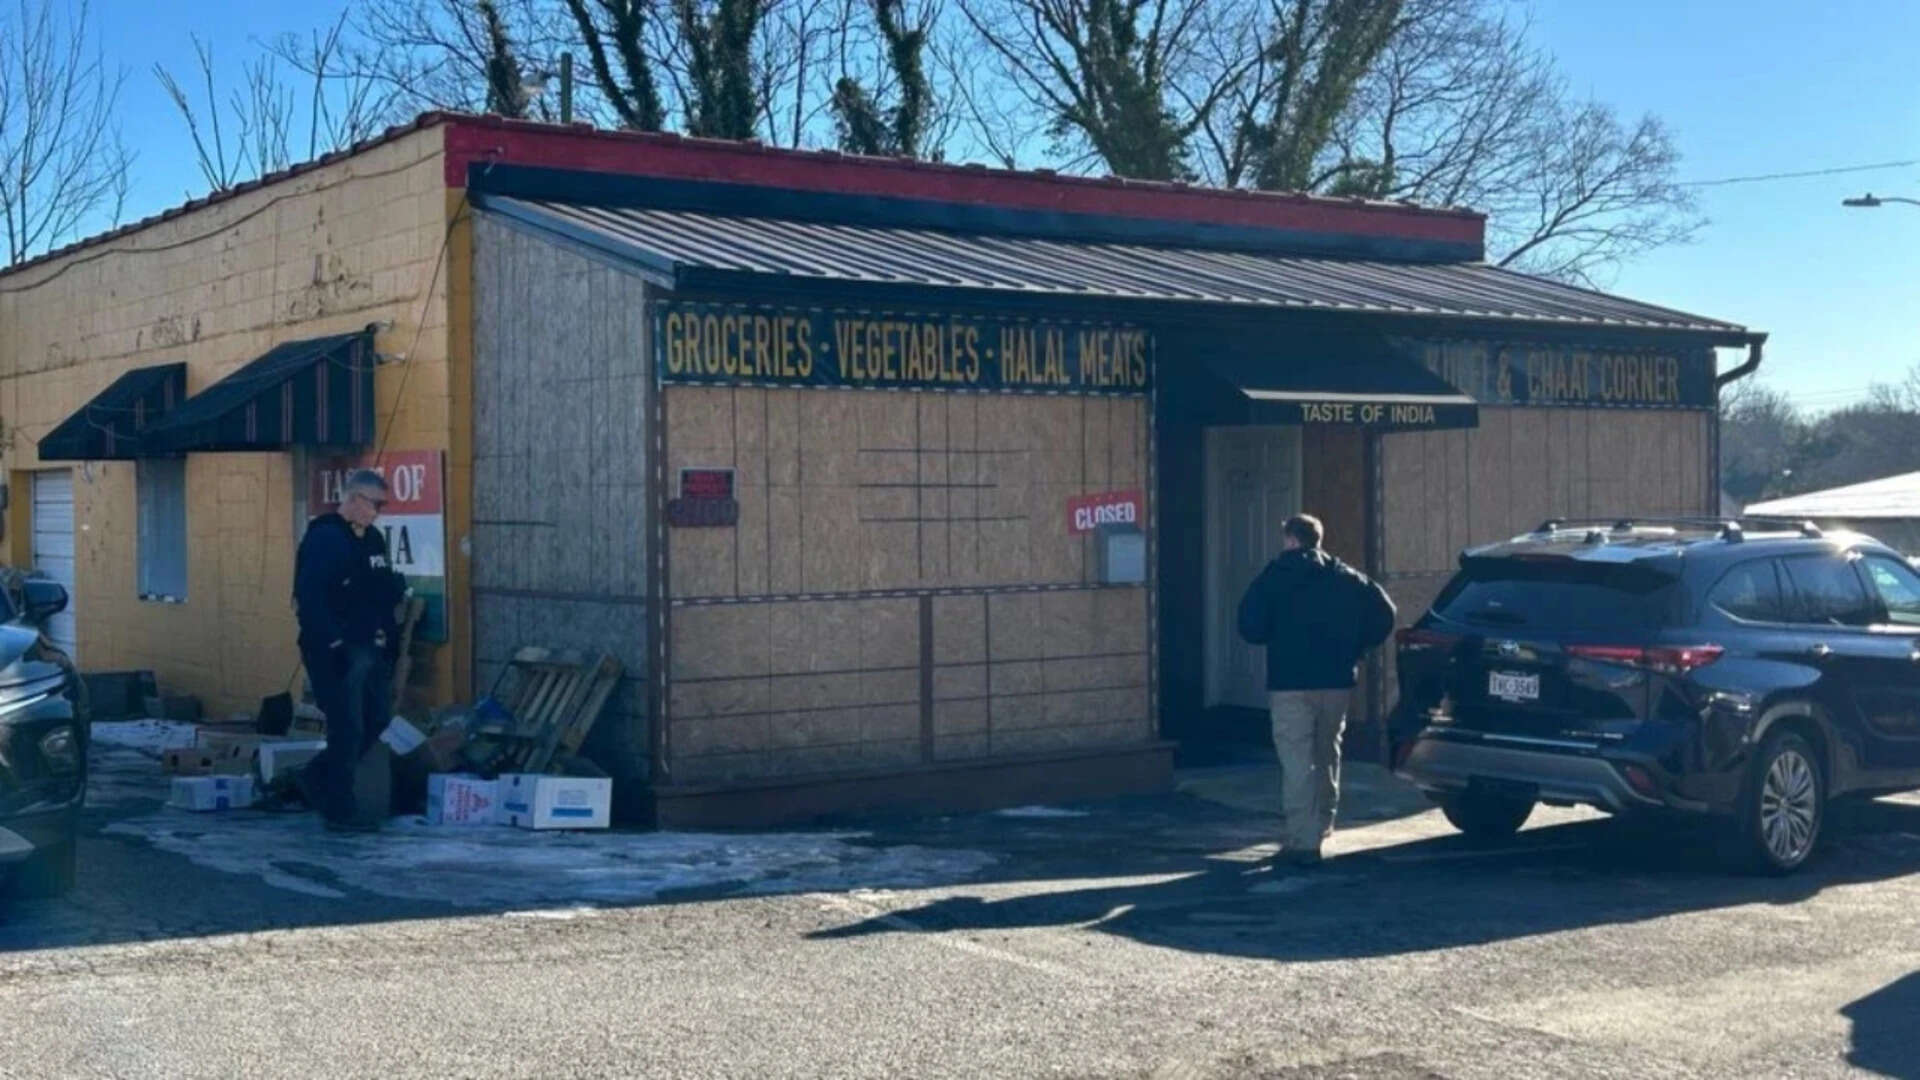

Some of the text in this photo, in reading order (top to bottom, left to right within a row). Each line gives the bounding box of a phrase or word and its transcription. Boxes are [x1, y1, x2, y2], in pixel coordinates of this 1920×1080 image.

[665, 312, 1146, 387] GROCERIES VEGETABLES HALAL MEATS
[1527, 350, 1592, 400] CHAAT
[1600, 354, 1679, 401] CORNER
[1300, 403, 1436, 423] TASTE OF INDIA
[393, 465, 425, 501] OF
[1075, 502, 1135, 530] CLOSED
